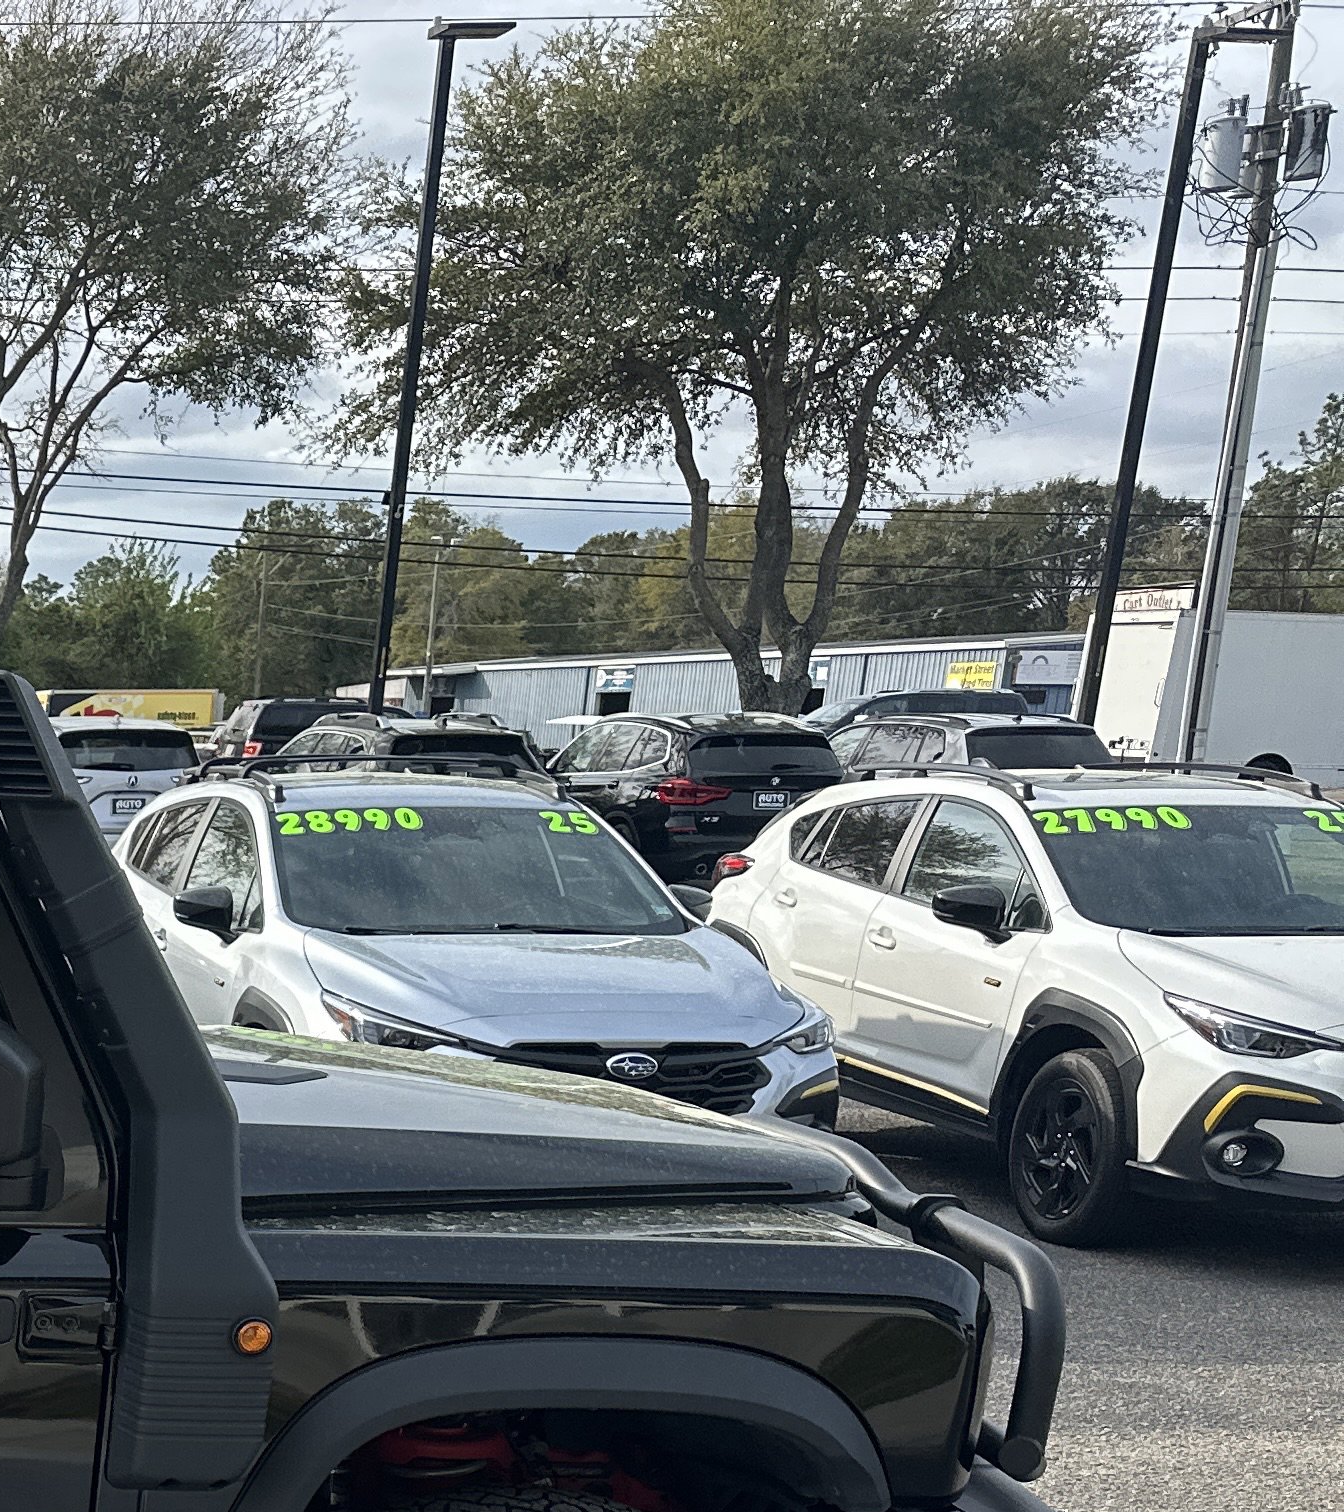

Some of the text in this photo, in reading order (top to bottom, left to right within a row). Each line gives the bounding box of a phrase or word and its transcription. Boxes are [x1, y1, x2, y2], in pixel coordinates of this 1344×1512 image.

[115, 799, 143, 809] AUTO
[758, 794, 785, 803] AUTO
[276, 807, 423, 835] 28990
[539, 811, 598, 834] 25
[1032, 806, 1192, 834] 27990
